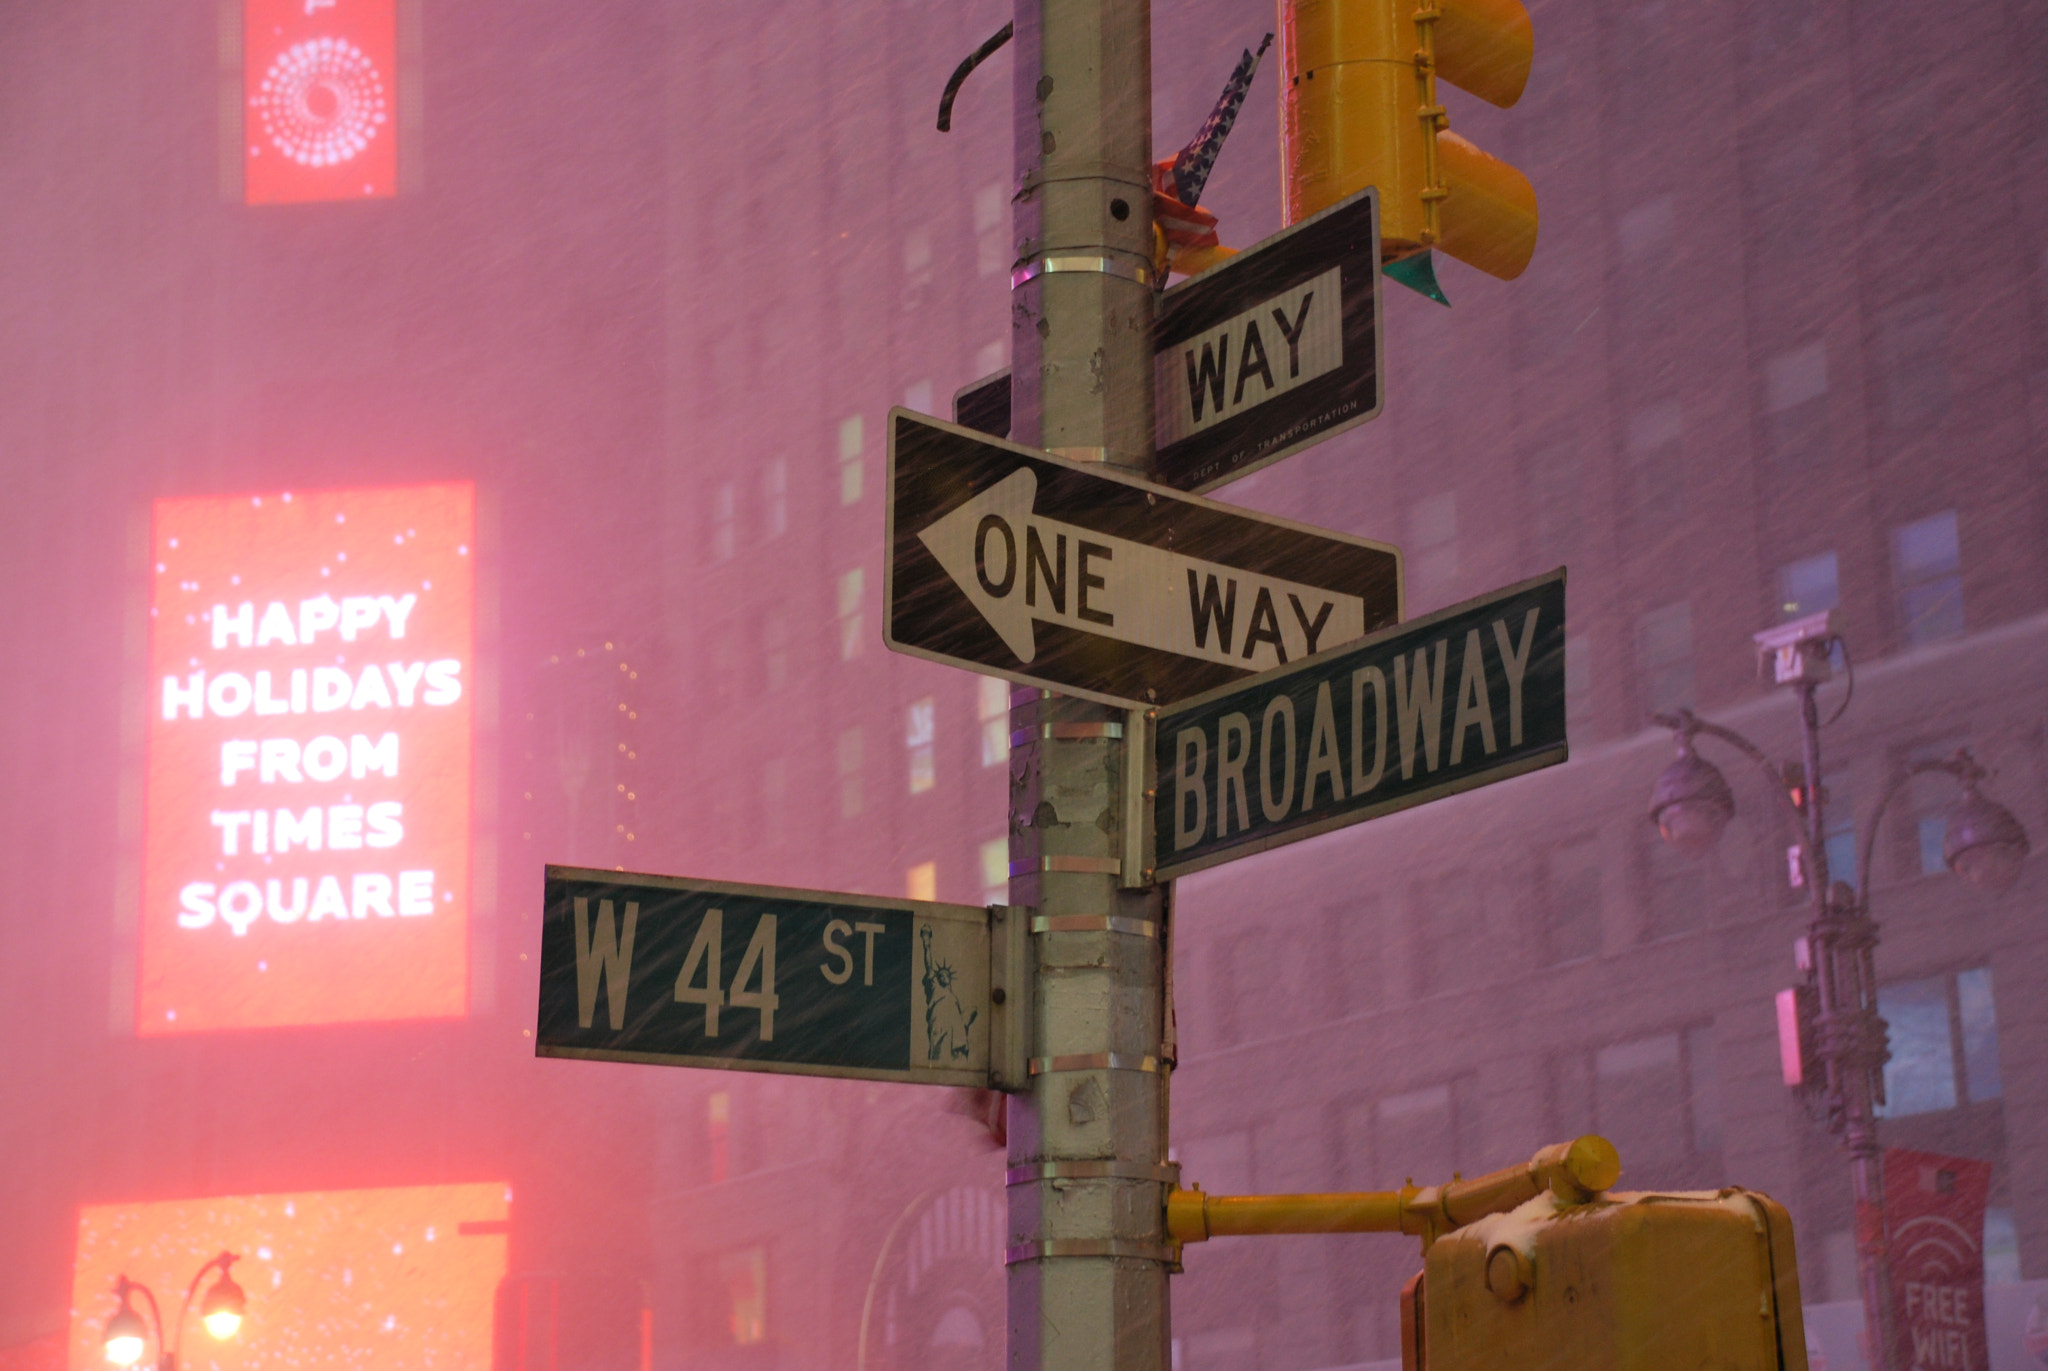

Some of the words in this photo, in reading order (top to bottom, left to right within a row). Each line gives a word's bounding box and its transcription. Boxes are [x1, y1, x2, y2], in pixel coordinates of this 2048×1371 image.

[1185, 291, 1314, 424] WAY
[1231, 451, 1246, 463] OF
[1257, 400, 1358, 451] TRANSPORTATION
[211, 593, 418, 649] HAPPY
[974, 513, 1114, 628] ONE
[1186, 568, 1334, 666] WAY
[161, 659, 462, 721] HOLIDAYS
[220, 731, 400, 787] FROM
[1174, 606, 1541, 852] BROADWAY
[210, 801, 404, 856] TIMES
[176, 869, 435, 937] SQUARE
[573, 896, 640, 1031] W
[673, 908, 780, 1042] 44
[819, 918, 886, 987] ST
[1905, 1281, 1970, 1325] FREE
